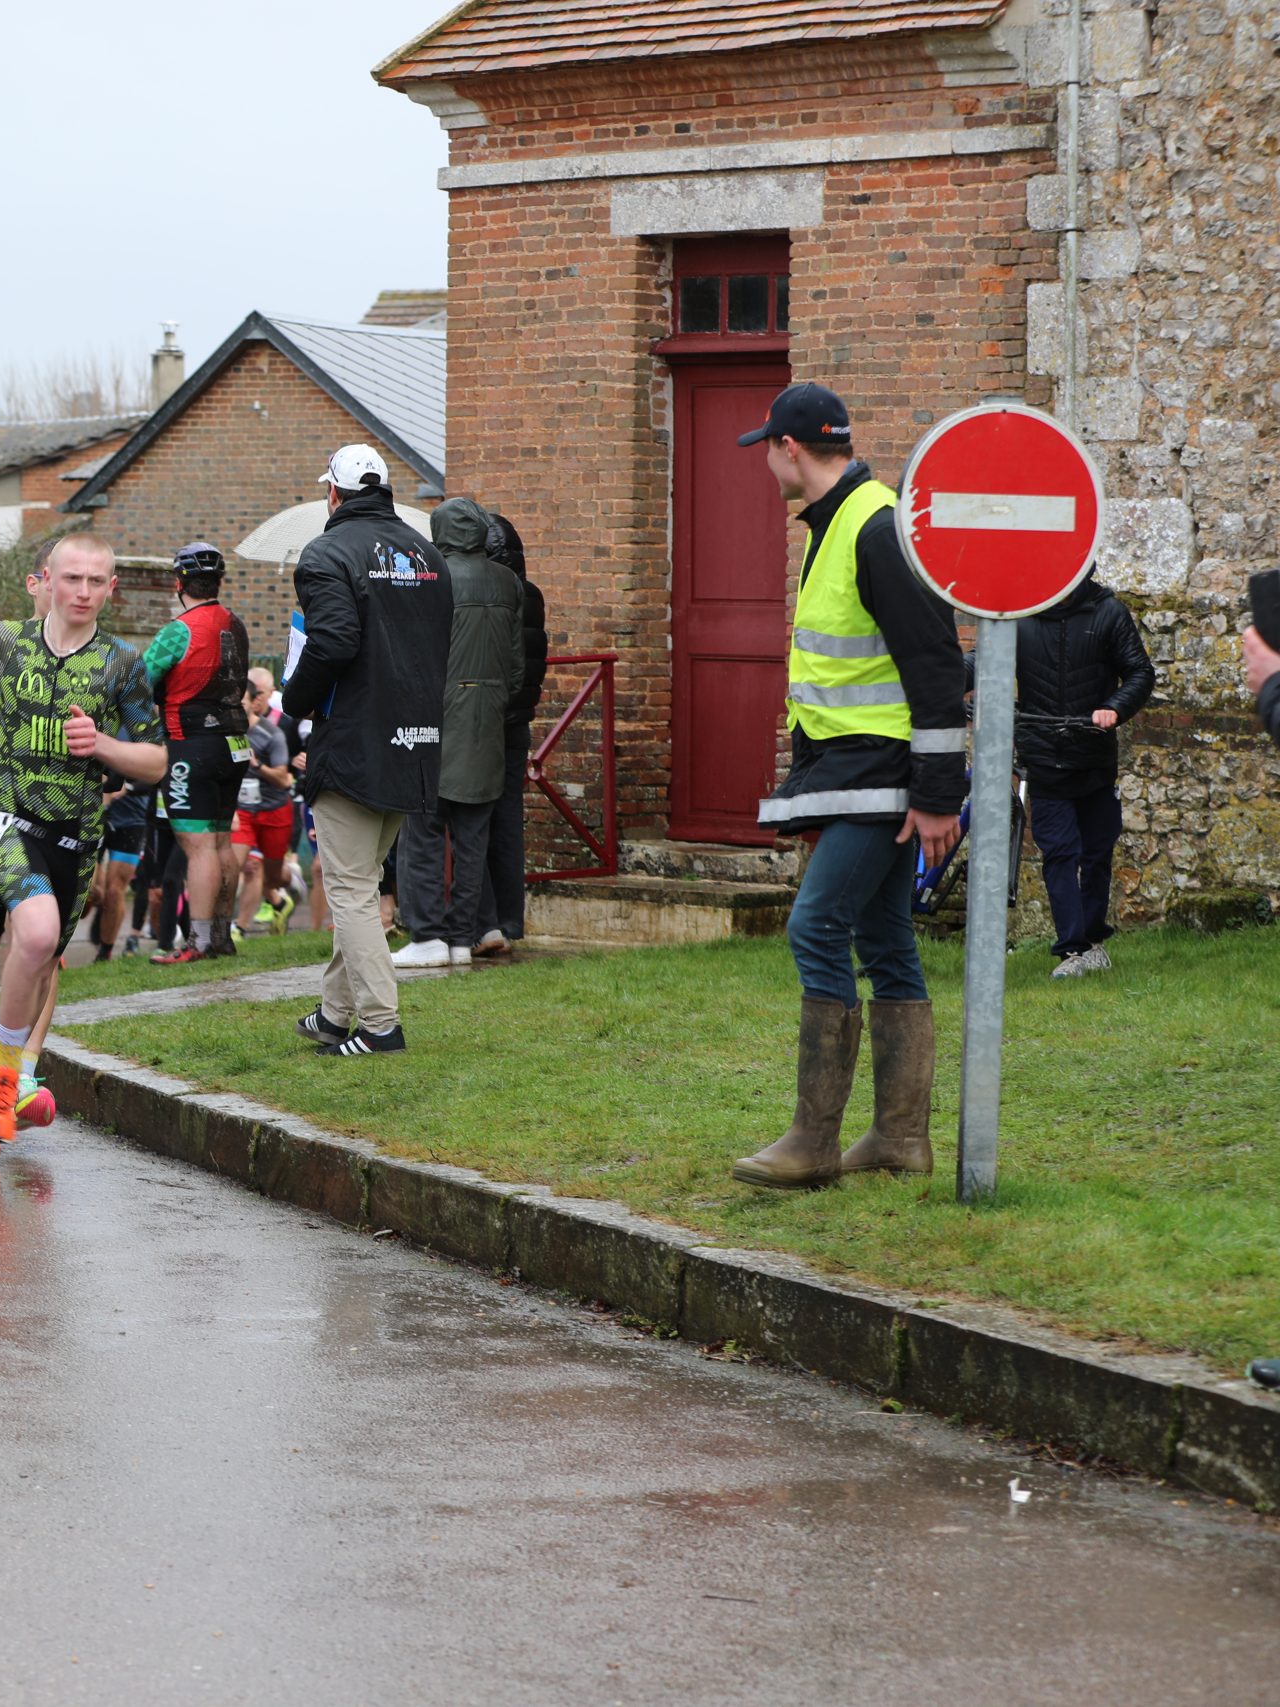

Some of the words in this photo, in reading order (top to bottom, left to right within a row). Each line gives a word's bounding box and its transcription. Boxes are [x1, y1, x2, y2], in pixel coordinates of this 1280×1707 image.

[368, 570, 389, 579] COACH
[389, 571, 416, 580] SPEAKER
[404, 726, 418, 735] LES
[168, 760, 191, 810] MAKO
